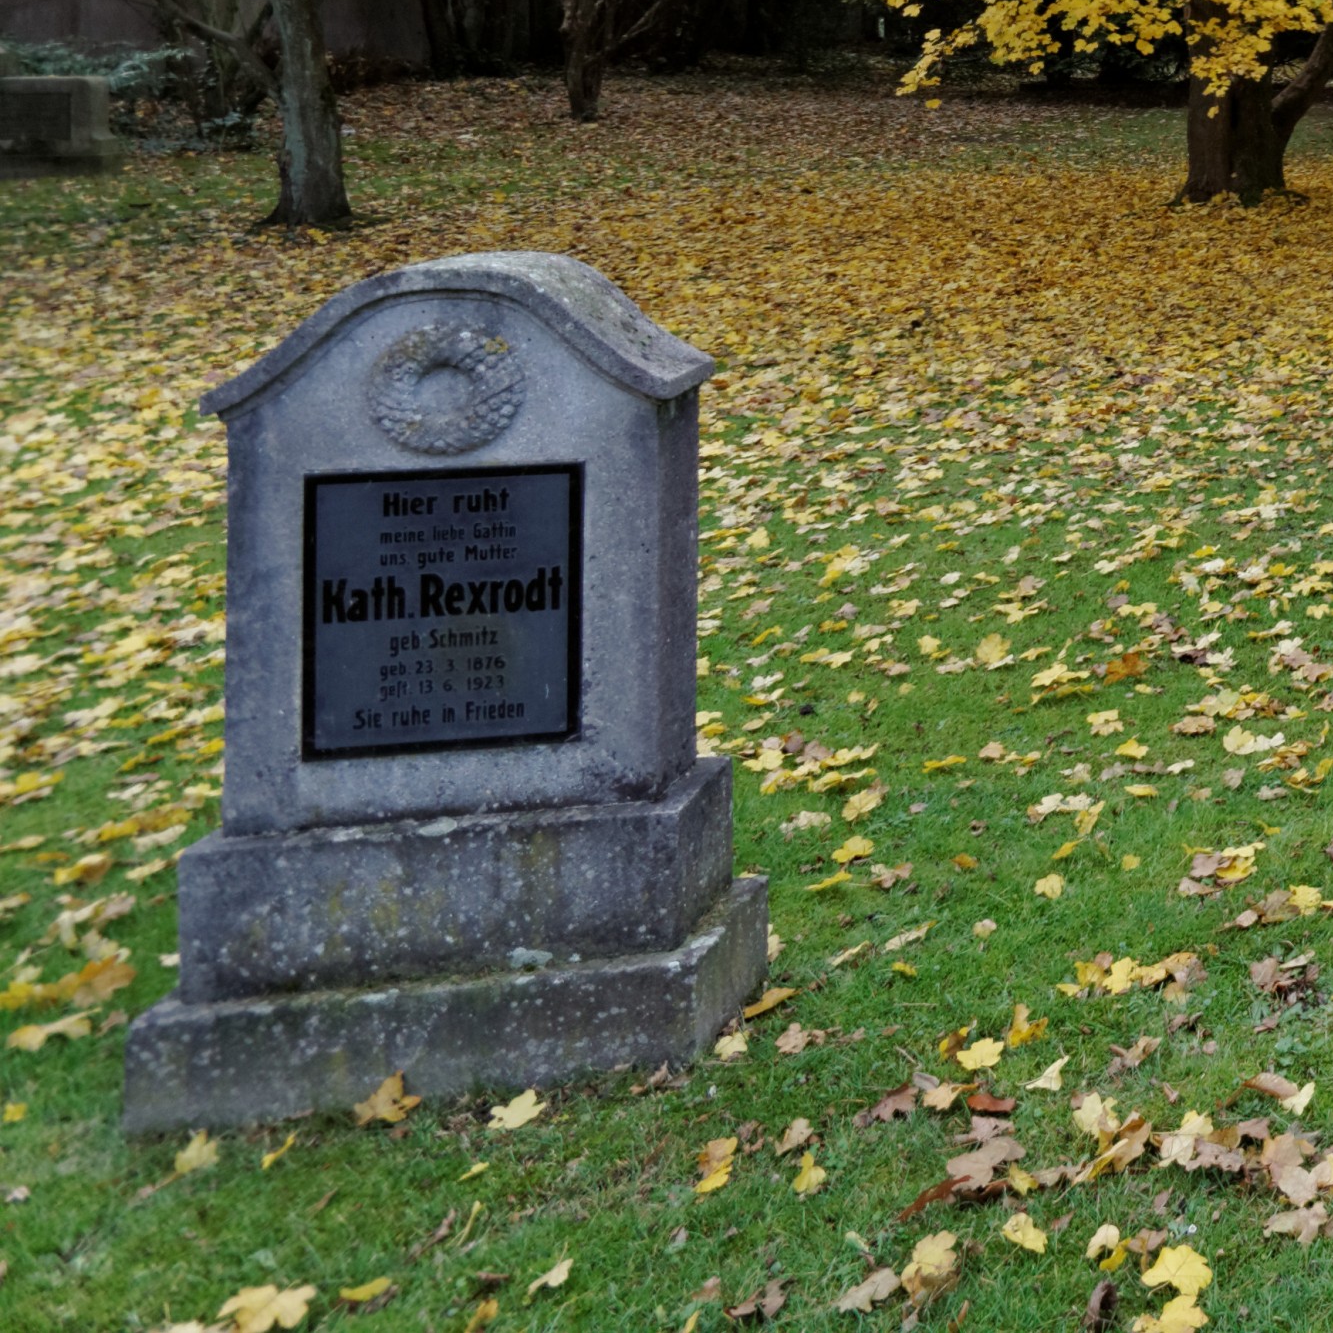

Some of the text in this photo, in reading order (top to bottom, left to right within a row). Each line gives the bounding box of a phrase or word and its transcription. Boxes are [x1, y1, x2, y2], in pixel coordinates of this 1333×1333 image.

[383, 487, 510, 517] Hier ruht
[380, 521, 516, 544] meine liebe Gattin
[417, 547, 455, 569] gute
[465, 544, 518, 562] Mutter
[322, 565, 563, 624] Kath. Rexrodt
[428, 626, 498, 649] Schmitz
[352, 698, 525, 730] Sie ruhe in Frieden
